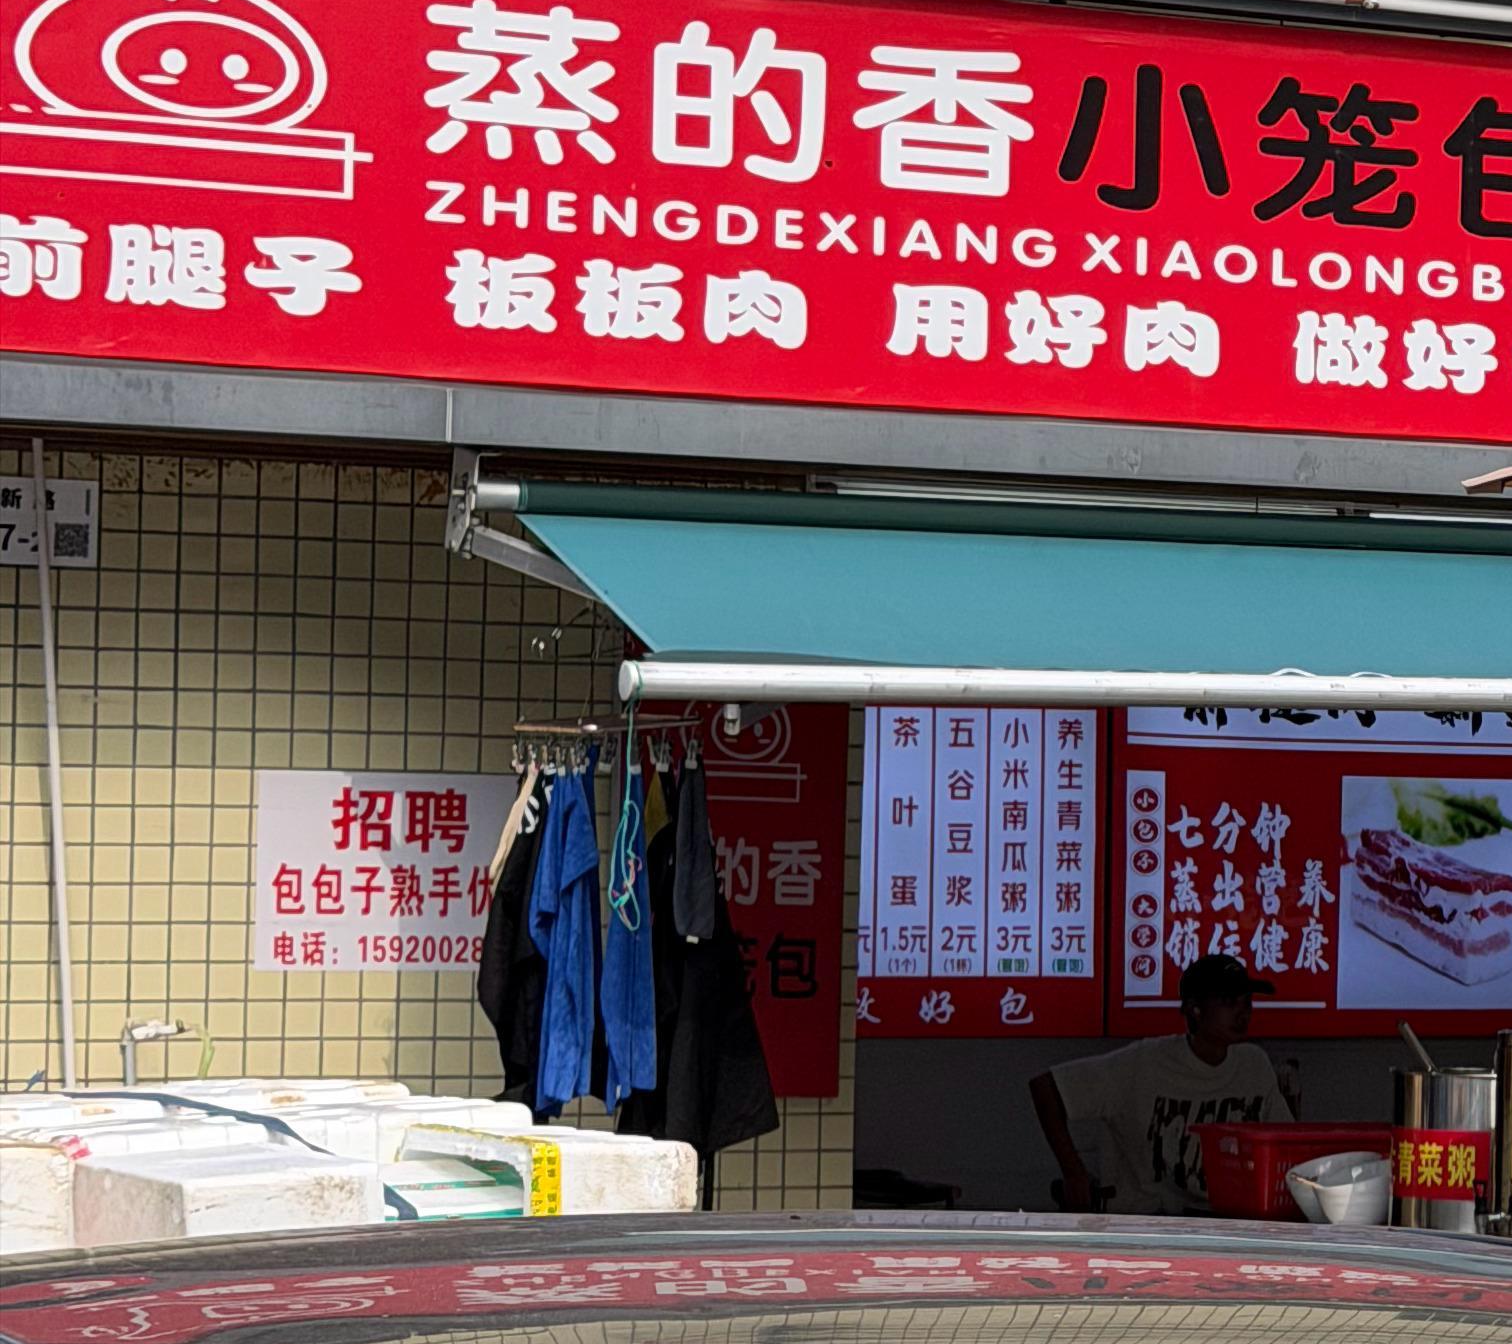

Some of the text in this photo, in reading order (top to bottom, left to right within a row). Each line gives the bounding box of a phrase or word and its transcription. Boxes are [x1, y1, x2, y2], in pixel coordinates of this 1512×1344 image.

[425, 180, 1056, 269] ZHENGDEXIANG
[332, 787, 470, 853] 招聘
[890, 716, 920, 907] 茶叶蛋
[945, 717, 976, 907] 五谷豆浆
[1001, 717, 1030, 914] 小米南瓜粥
[1056, 718, 1085, 914] 养生青菜粥
[1166, 801, 1292, 860] 七分钟
[1169, 856, 1336, 917] 蒸出营养
[880, 926, 927, 953] 1.5元
[941, 926, 977, 953] 2元
[996, 926, 1032, 953] 3元
[1051, 926, 1087, 953] 3元
